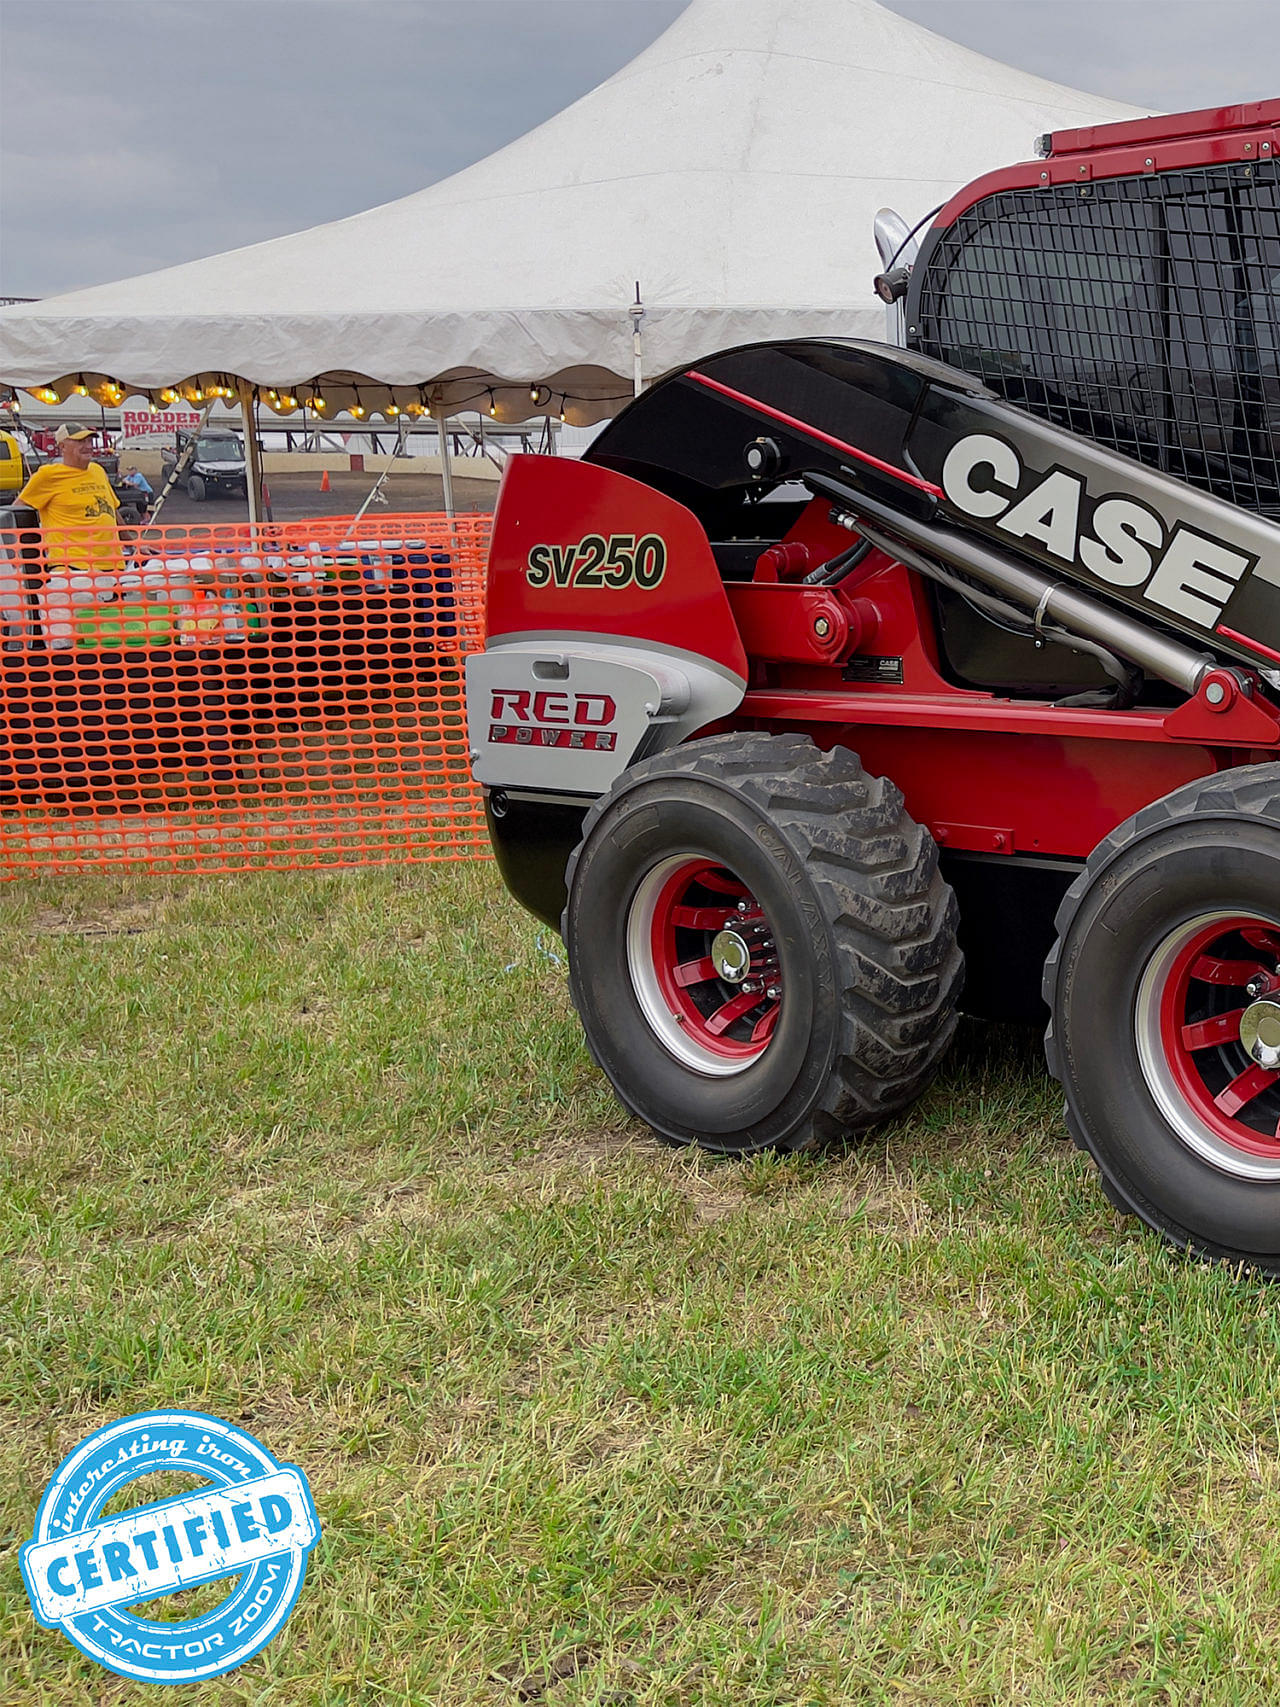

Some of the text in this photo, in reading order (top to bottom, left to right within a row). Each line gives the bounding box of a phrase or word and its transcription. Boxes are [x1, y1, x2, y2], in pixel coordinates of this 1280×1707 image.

[123, 411, 201, 423] ROEDER
[123, 424, 200, 439] IMPLEM
[941, 433, 1251, 630] CASE
[526, 533, 667, 590] SV250
[490, 689, 616, 725] RED
[492, 726, 613, 750] POWER
